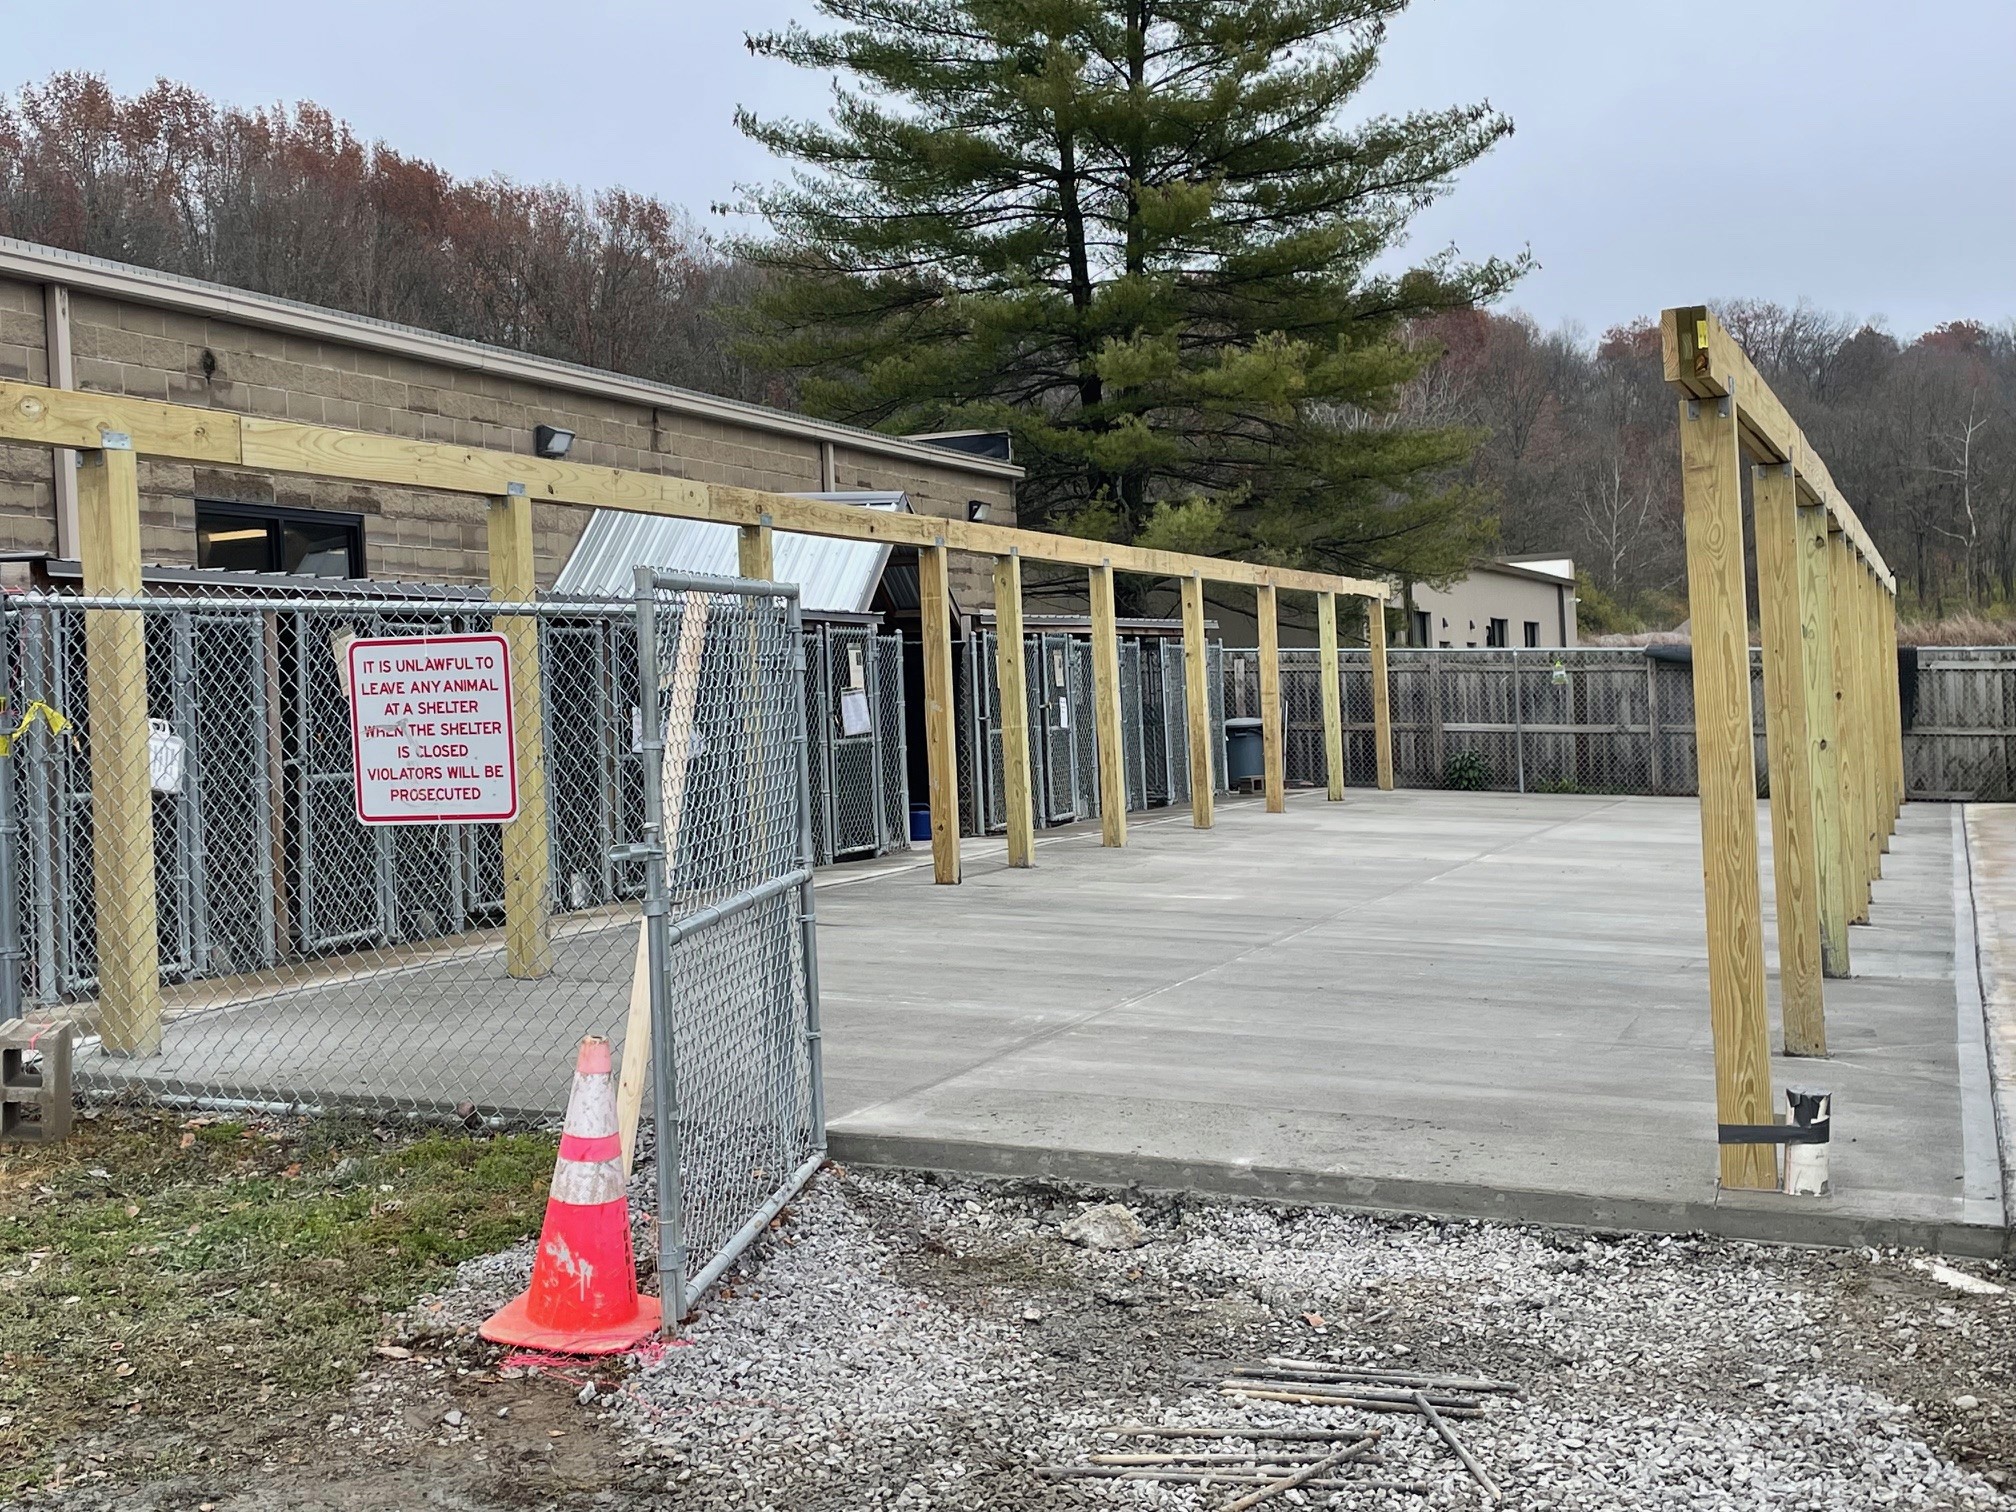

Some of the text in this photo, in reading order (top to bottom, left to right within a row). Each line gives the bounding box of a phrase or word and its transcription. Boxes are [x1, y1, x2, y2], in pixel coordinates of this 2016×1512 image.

[363, 657, 494, 673] IT IS UNLAWFUL TO
[362, 679, 498, 695] LEAVE ANY ANIMAL
[385, 701, 478, 715] AT A SHELTER
[409, 724, 435, 736] THE
[441, 722, 501, 735] SHELTER
[398, 745, 468, 758] IS CLOSED
[367, 765, 504, 780] VIOLATORS WILL BE
[391, 788, 481, 801] PROSECUTED
